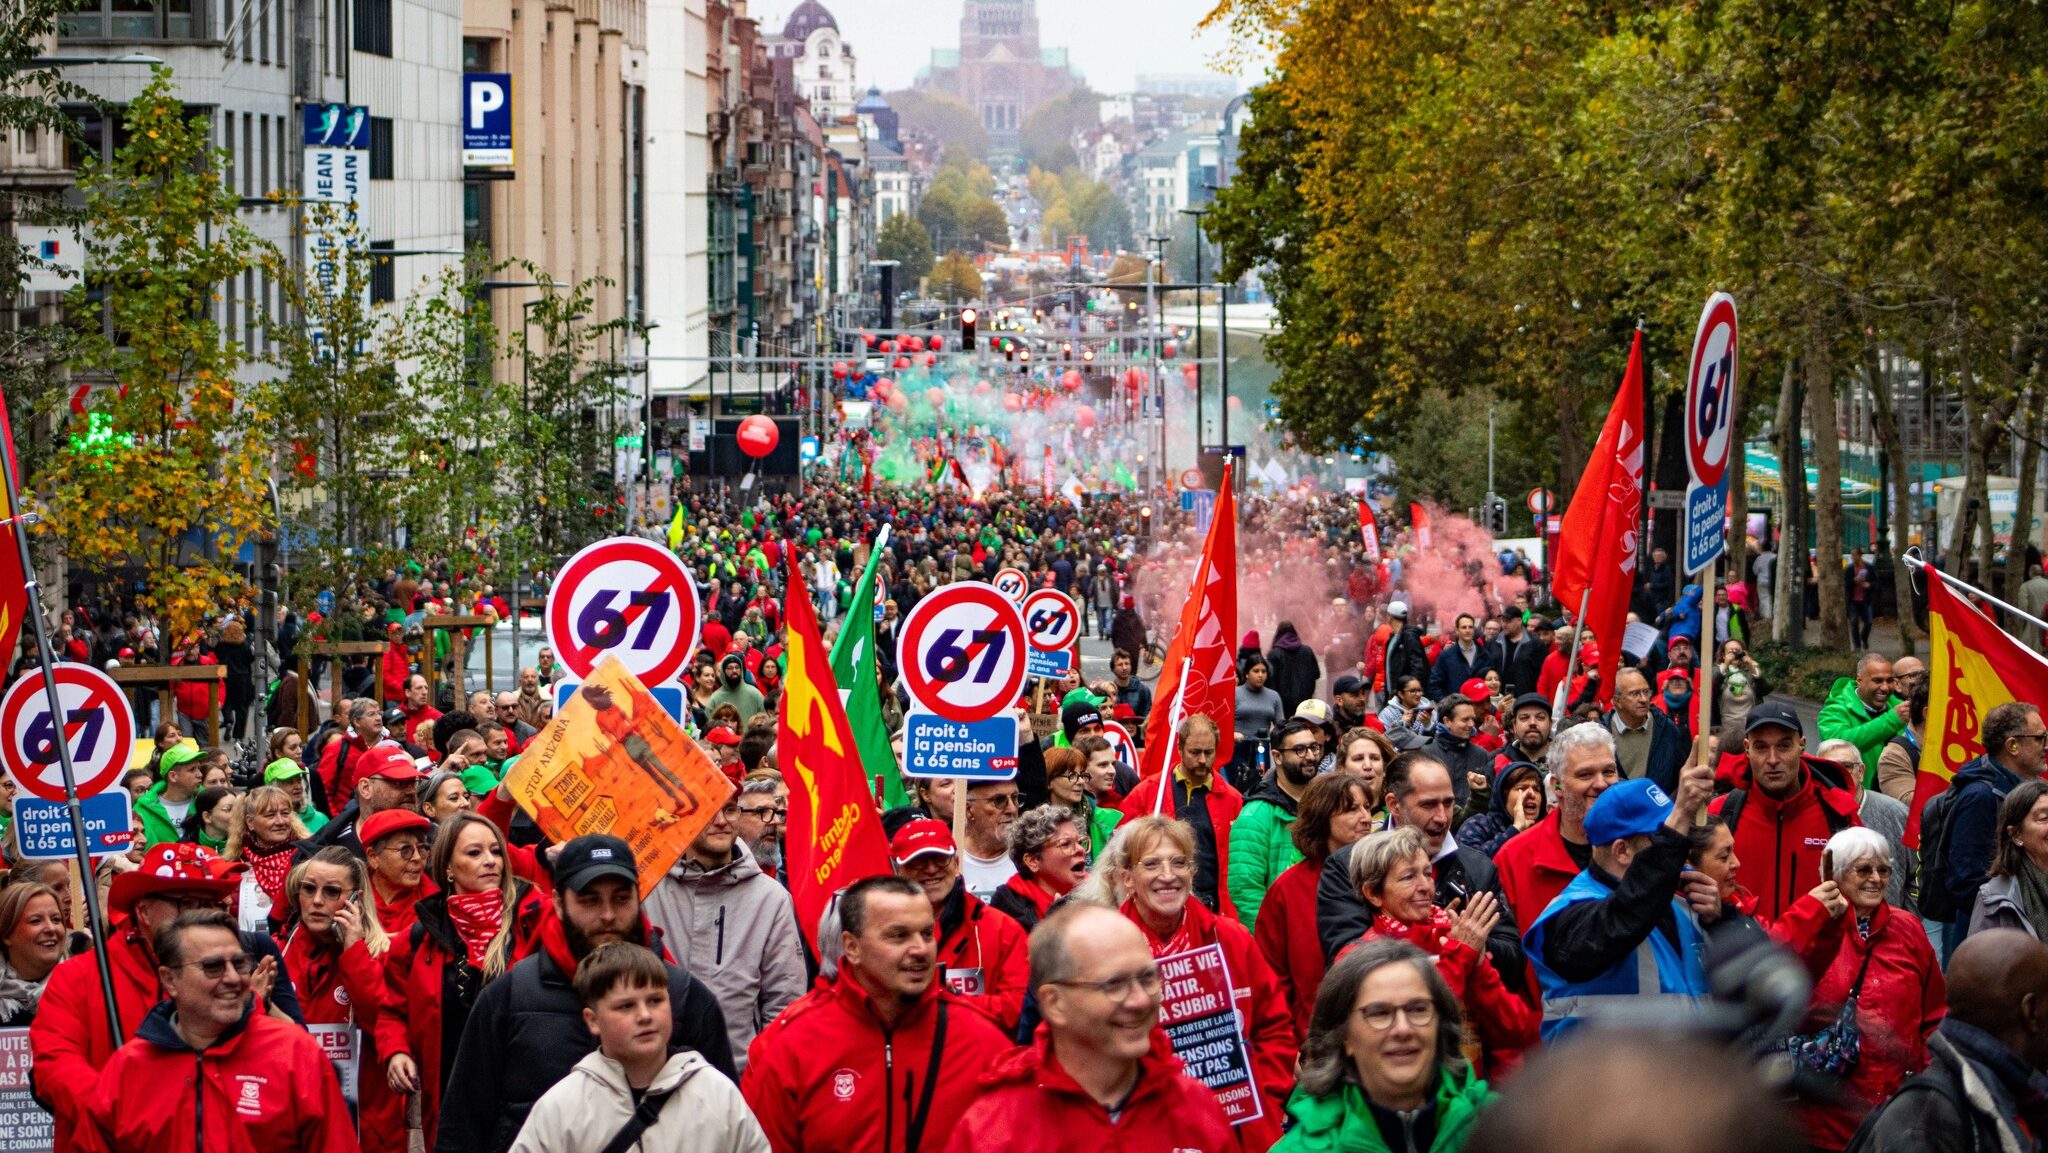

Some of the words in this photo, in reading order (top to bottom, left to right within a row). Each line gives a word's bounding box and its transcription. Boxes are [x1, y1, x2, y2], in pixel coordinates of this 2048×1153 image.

[471, 82, 504, 129] P
[1700, 350, 1732, 440] 67
[1692, 493, 1711, 519] droit
[1713, 488, 1718, 507] à
[1692, 520, 1700, 539] la
[1692, 541, 1698, 560] à
[1699, 535, 1708, 556] 65
[1709, 529, 1720, 549] ans
[1000, 579, 1021, 594] 67
[577, 589, 671, 650] 67
[1030, 608, 1068, 636] 67
[926, 629, 1007, 684] 67
[1030, 650, 1040, 658] oit
[1037, 665, 1050, 673] ans
[22, 707, 105, 765] 67
[915, 723, 955, 739] droit
[958, 724, 969, 738] à
[915, 737, 930, 752] la
[933, 739, 996, 758] pension
[525, 768, 543, 798] STOP
[540, 719, 570, 768] ARIZONA
[914, 752, 925, 767] à
[928, 754, 949, 768] 65
[952, 757, 981, 769] ans
[1004, 757, 1016, 766] ptb
[554, 769, 579, 795] TEMPS
[22, 807, 61, 820] droit
[24, 822, 37, 834] la
[41, 816, 106, 837] penion
[25, 834, 35, 850] à
[37, 835, 57, 849] 65
[117, 832, 131, 842] ptb
[1162, 957, 1194, 980] UNE
[1195, 950, 1221, 971] VIE
[1171, 993, 1217, 1019] SUBIR
[1218, 990, 1226, 1007] !
[1177, 1018, 1213, 1035] PORTENT
[1213, 1014, 1224, 1026] LA
[0, 1036, 28, 1052] UTE
[1172, 1032, 1205, 1048] TRAVAIL
[6, 1051, 17, 1069] À
[1205, 1055, 1231, 1074] PAS
[0, 1072, 17, 1085] AS
[2, 1091, 32, 1100] FEMMES
[17, 1101, 26, 1110] LE
[22, 1111, 54, 1125] PENS
[17, 1124, 50, 1138] SONT
